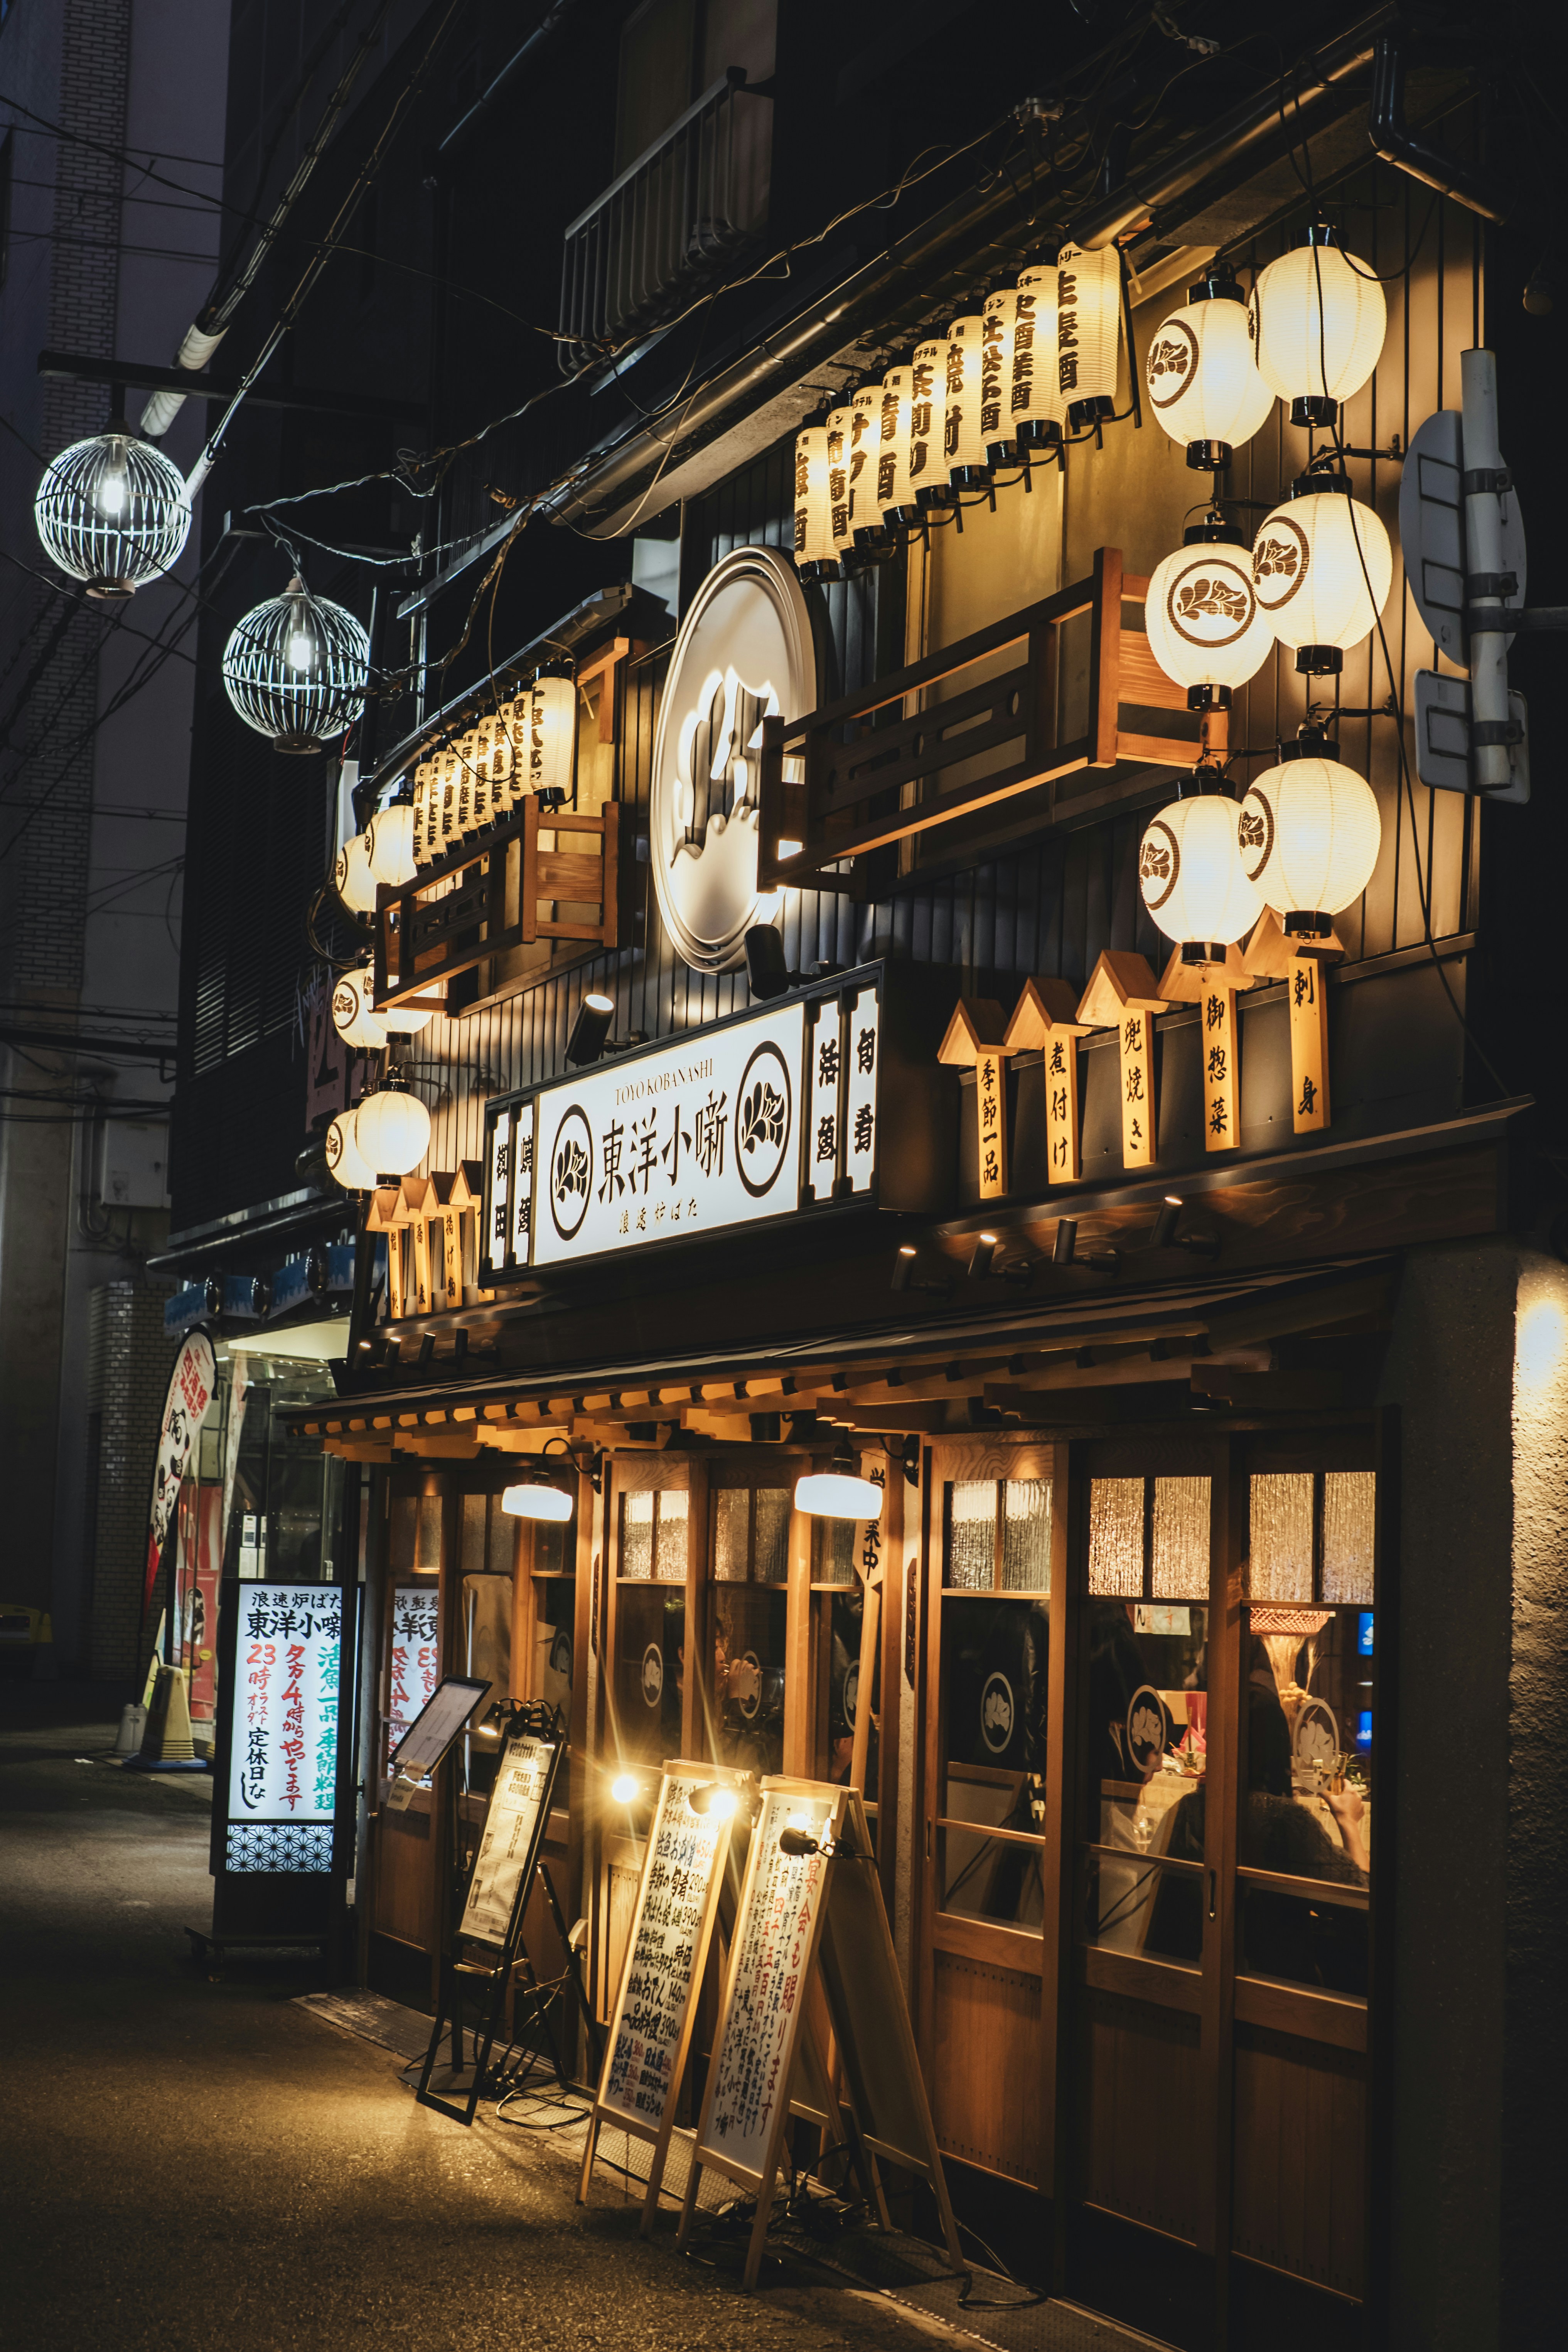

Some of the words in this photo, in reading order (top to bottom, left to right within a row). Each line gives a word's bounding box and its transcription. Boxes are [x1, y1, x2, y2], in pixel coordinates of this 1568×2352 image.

[647, 1058, 713, 1096] KOBANASHI
[1125, 1018, 1144, 1150] 兜焼き
[1207, 995, 1228, 1134] 御惣菜
[1293, 967, 1318, 1115] 刺身
[598, 1089, 728, 1204] 東洋小噺
[980, 1059, 998, 1184] 季節一品
[1050, 1042, 1067, 1167] 煮付け
[447, 1214, 455, 1298] 揚げ物
[244, 1608, 341, 1639] 東洋小噺
[252, 1591, 342, 1608] 浪速炉ばた
[279, 1644, 306, 1811] 夕方4時からやってます
[313, 1727, 338, 1811] 季節料理
[620, 1998, 663, 2041] 一品料理
